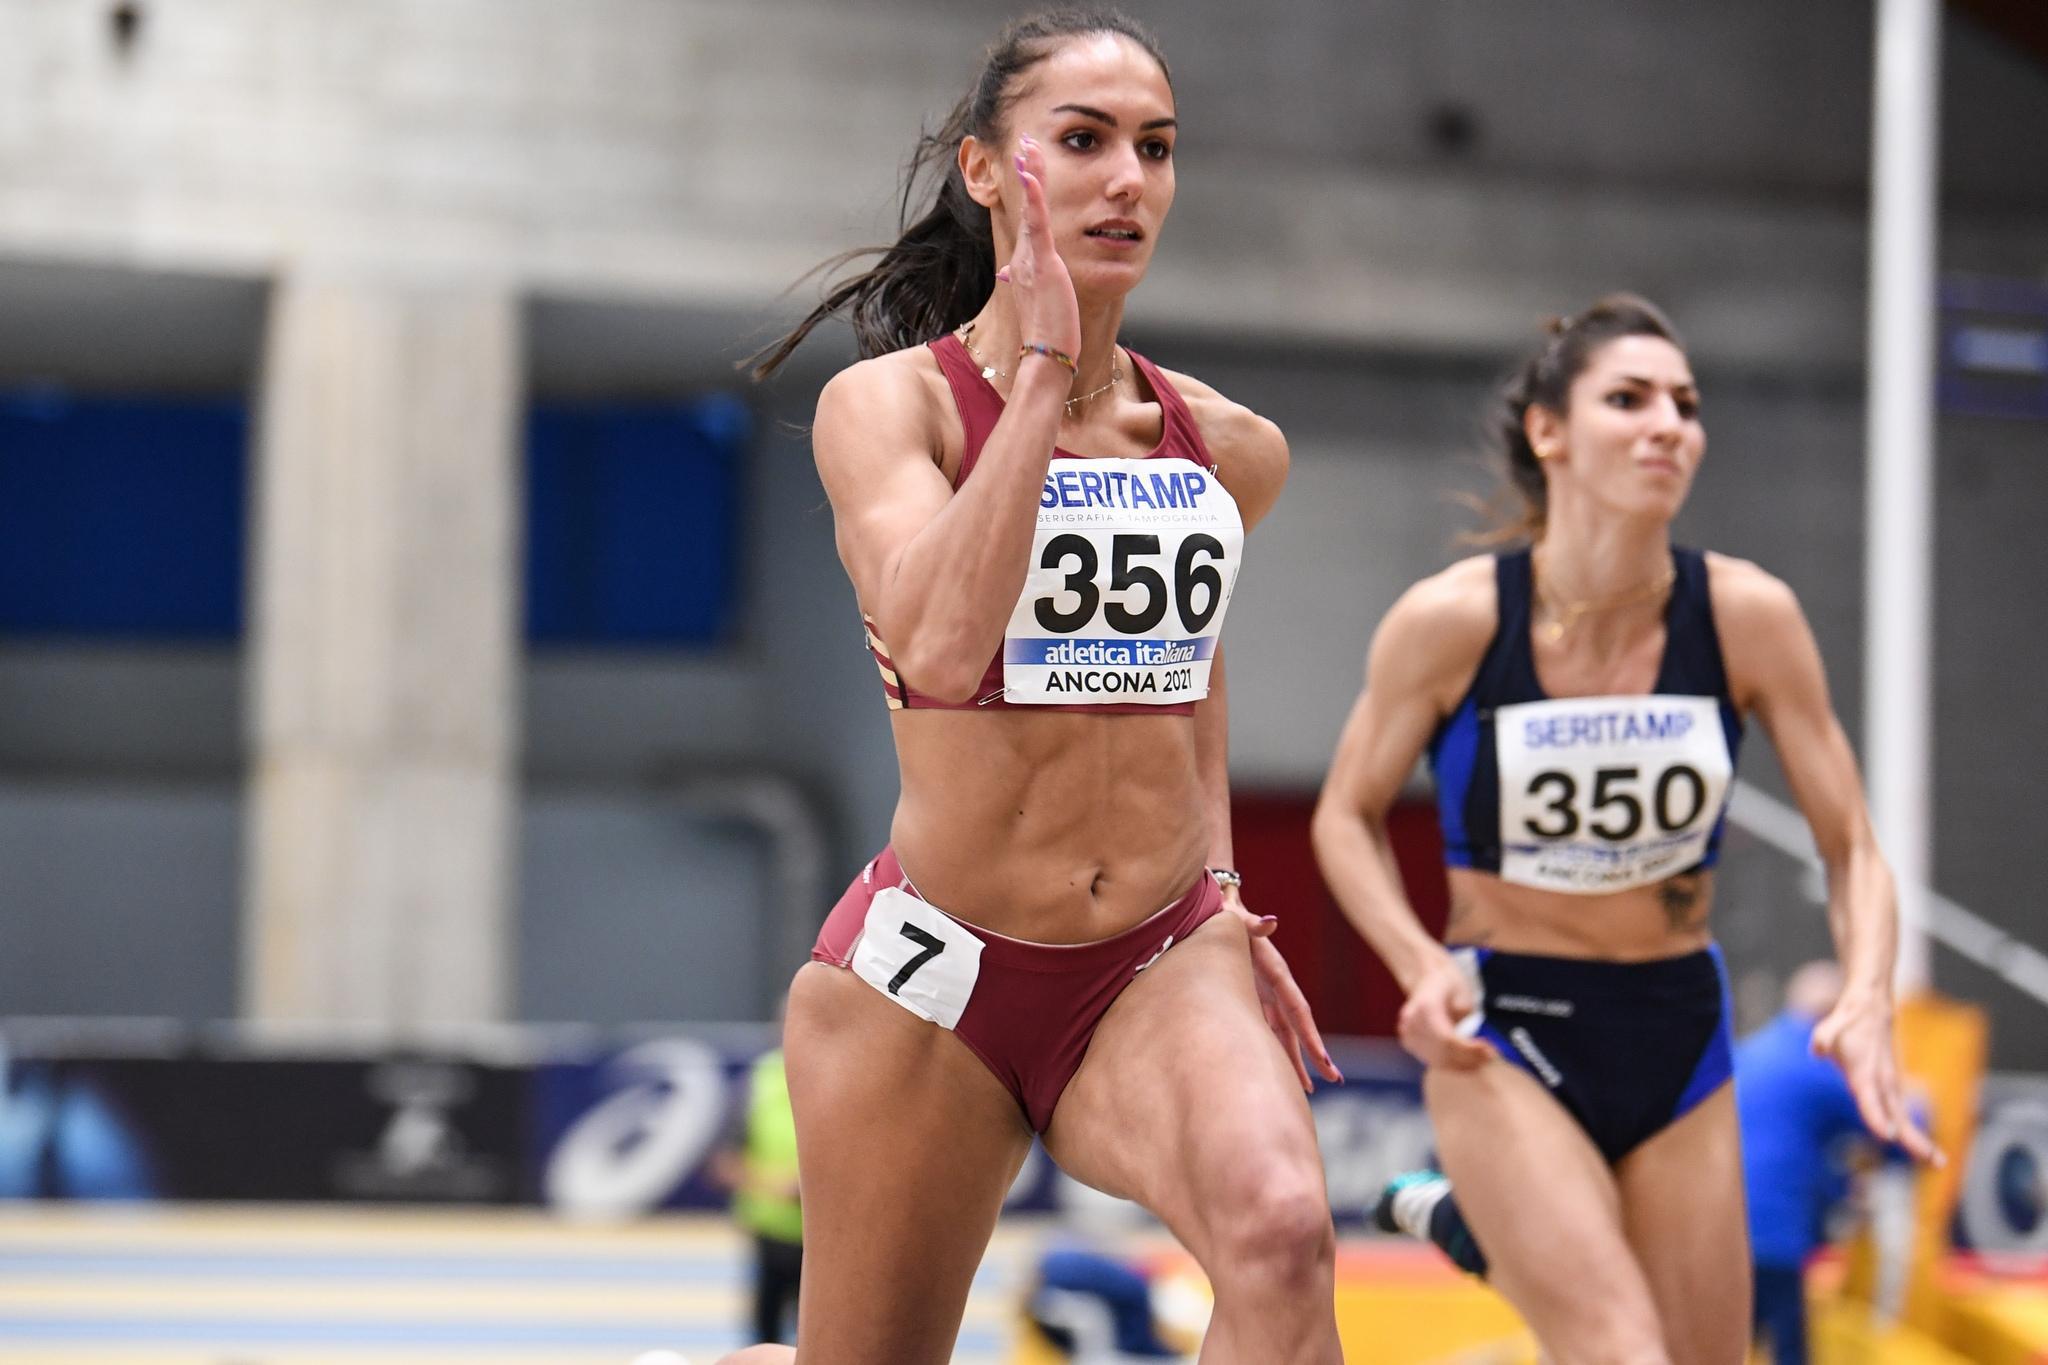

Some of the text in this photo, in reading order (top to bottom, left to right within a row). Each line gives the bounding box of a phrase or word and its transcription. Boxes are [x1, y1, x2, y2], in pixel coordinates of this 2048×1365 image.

[1040, 471, 1207, 509] SERITAMP
[1038, 513, 1114, 523] SERIGRAFIA
[1128, 514, 1218, 522] TAMPOGRAFIA
[1034, 533, 1225, 635] 356
[1045, 639, 1197, 665] atletica italiana
[1045, 668, 1192, 692] ANCONA 2021
[1523, 711, 1695, 748] SERITAMP
[1523, 764, 1707, 841] 350
[887, 921, 946, 997] 7
